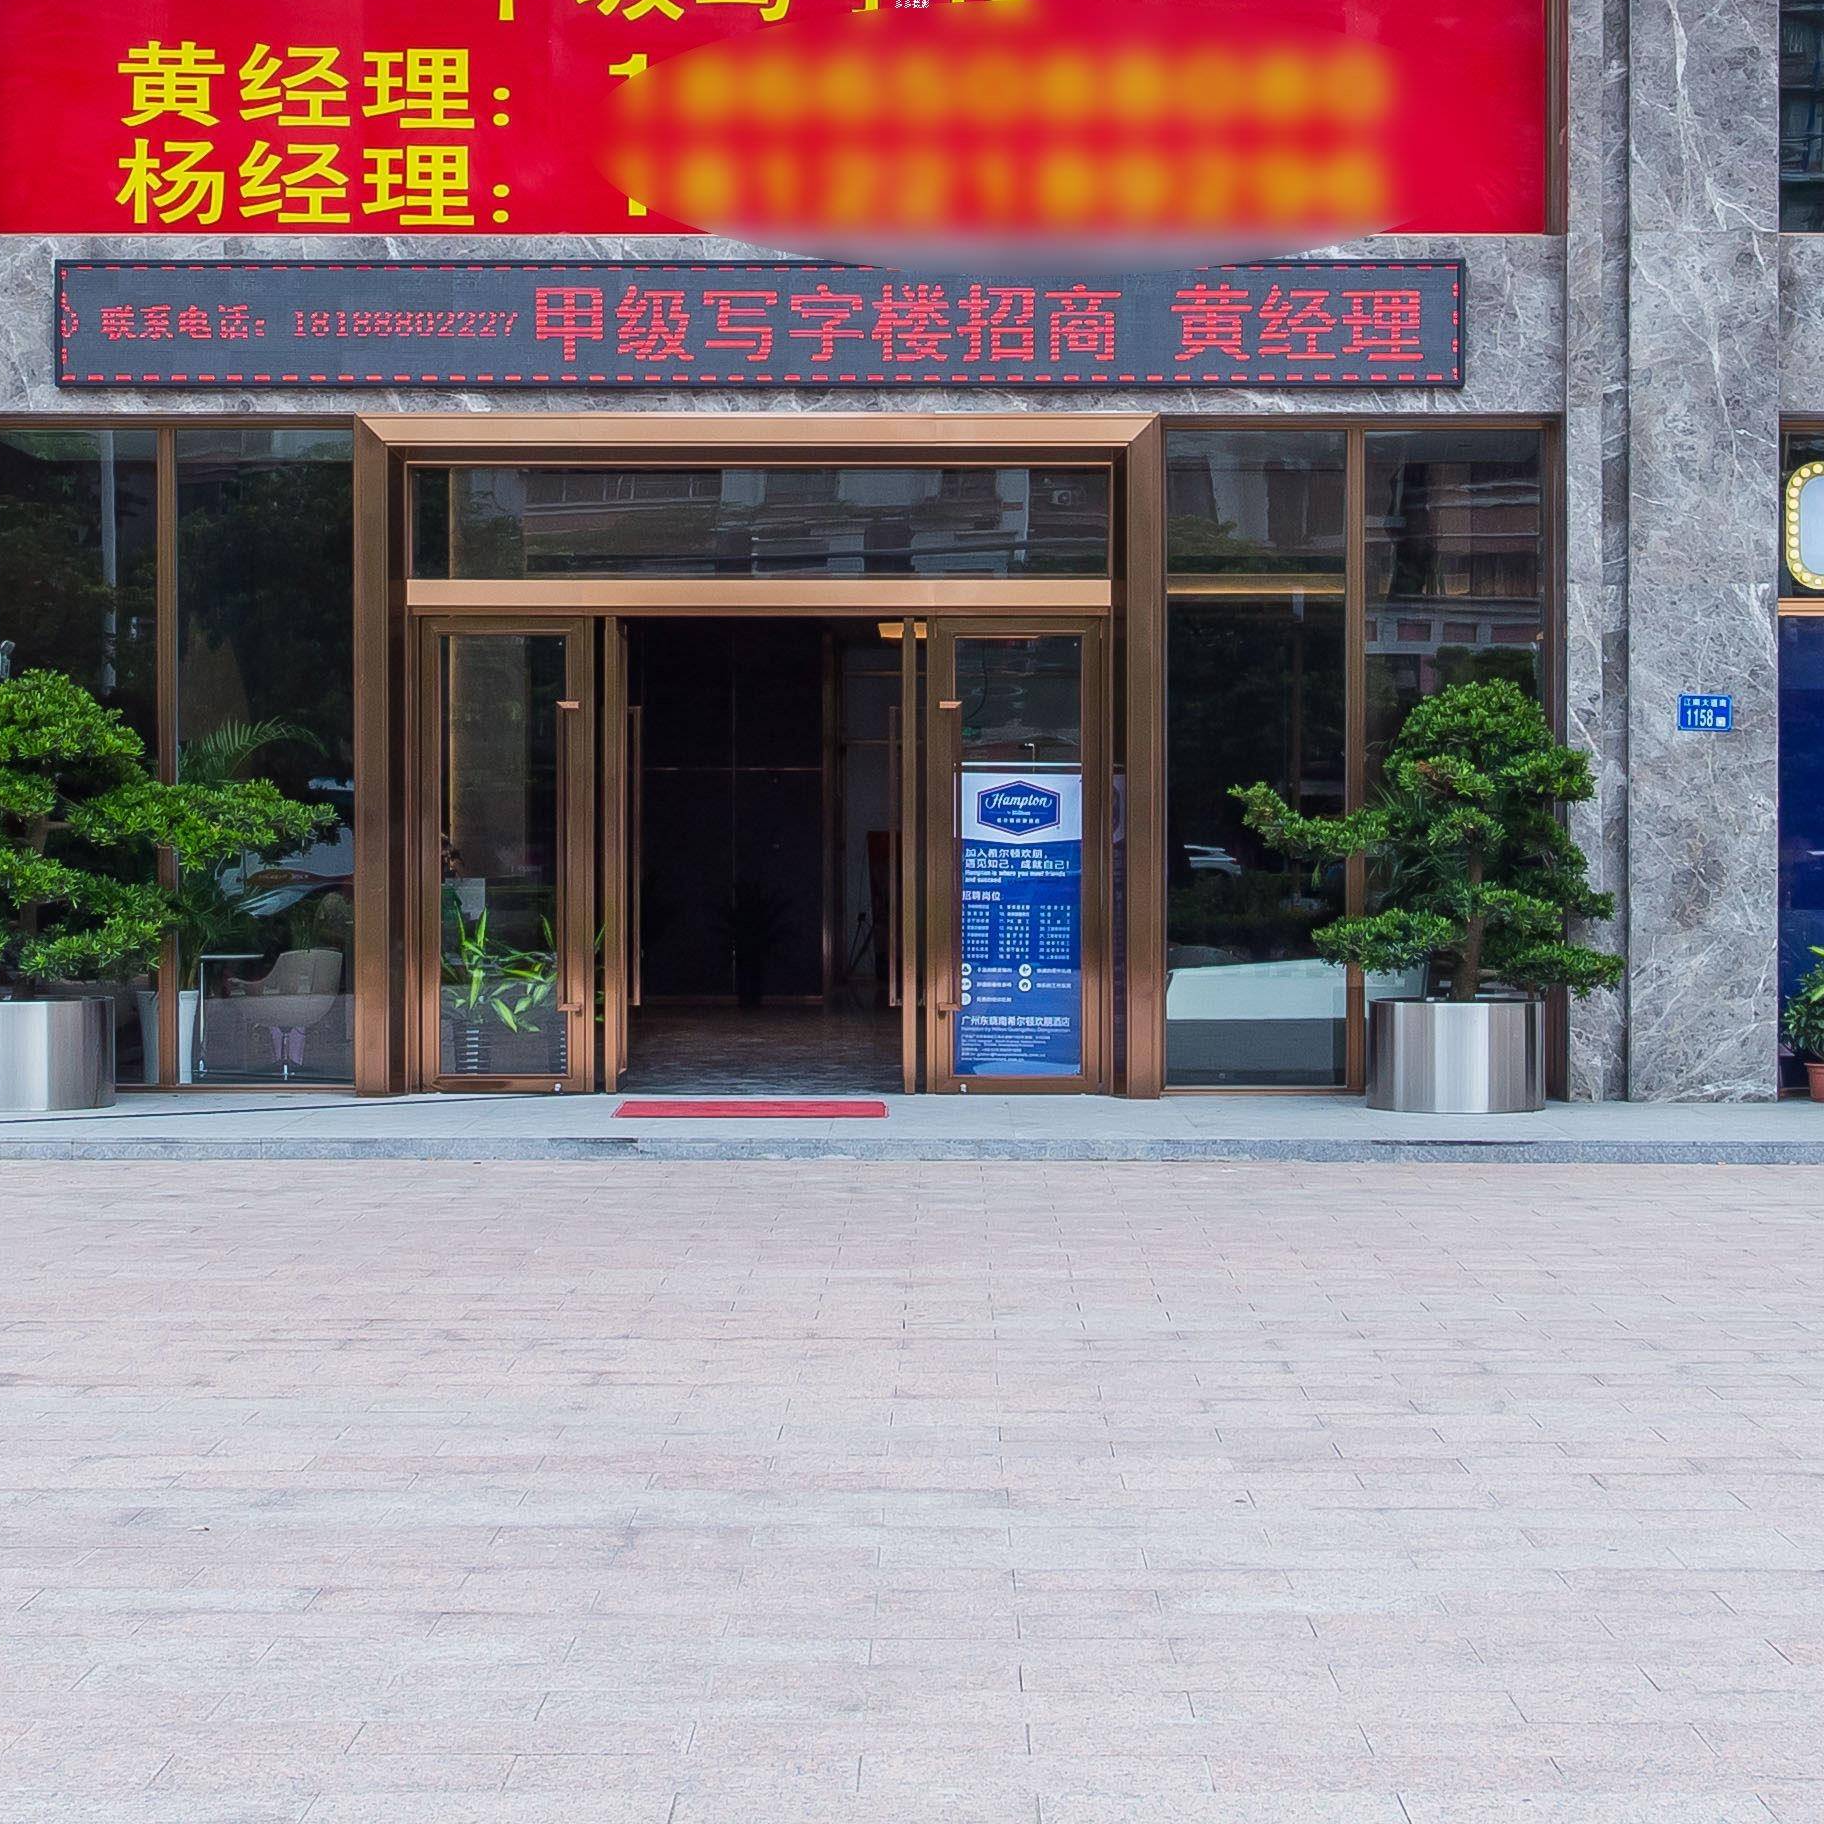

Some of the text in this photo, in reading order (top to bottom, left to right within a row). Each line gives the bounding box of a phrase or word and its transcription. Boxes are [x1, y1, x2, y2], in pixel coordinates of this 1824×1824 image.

[116, 40, 511, 130] 黄经理：
[115, 137, 511, 226] 杨经理：
[534, 283, 1122, 363] 甲级写字楼招商
[1171, 283, 1425, 363] 黄经理
[1686, 709, 1714, 727] 1158
[985, 792, 1053, 810] Hampton
